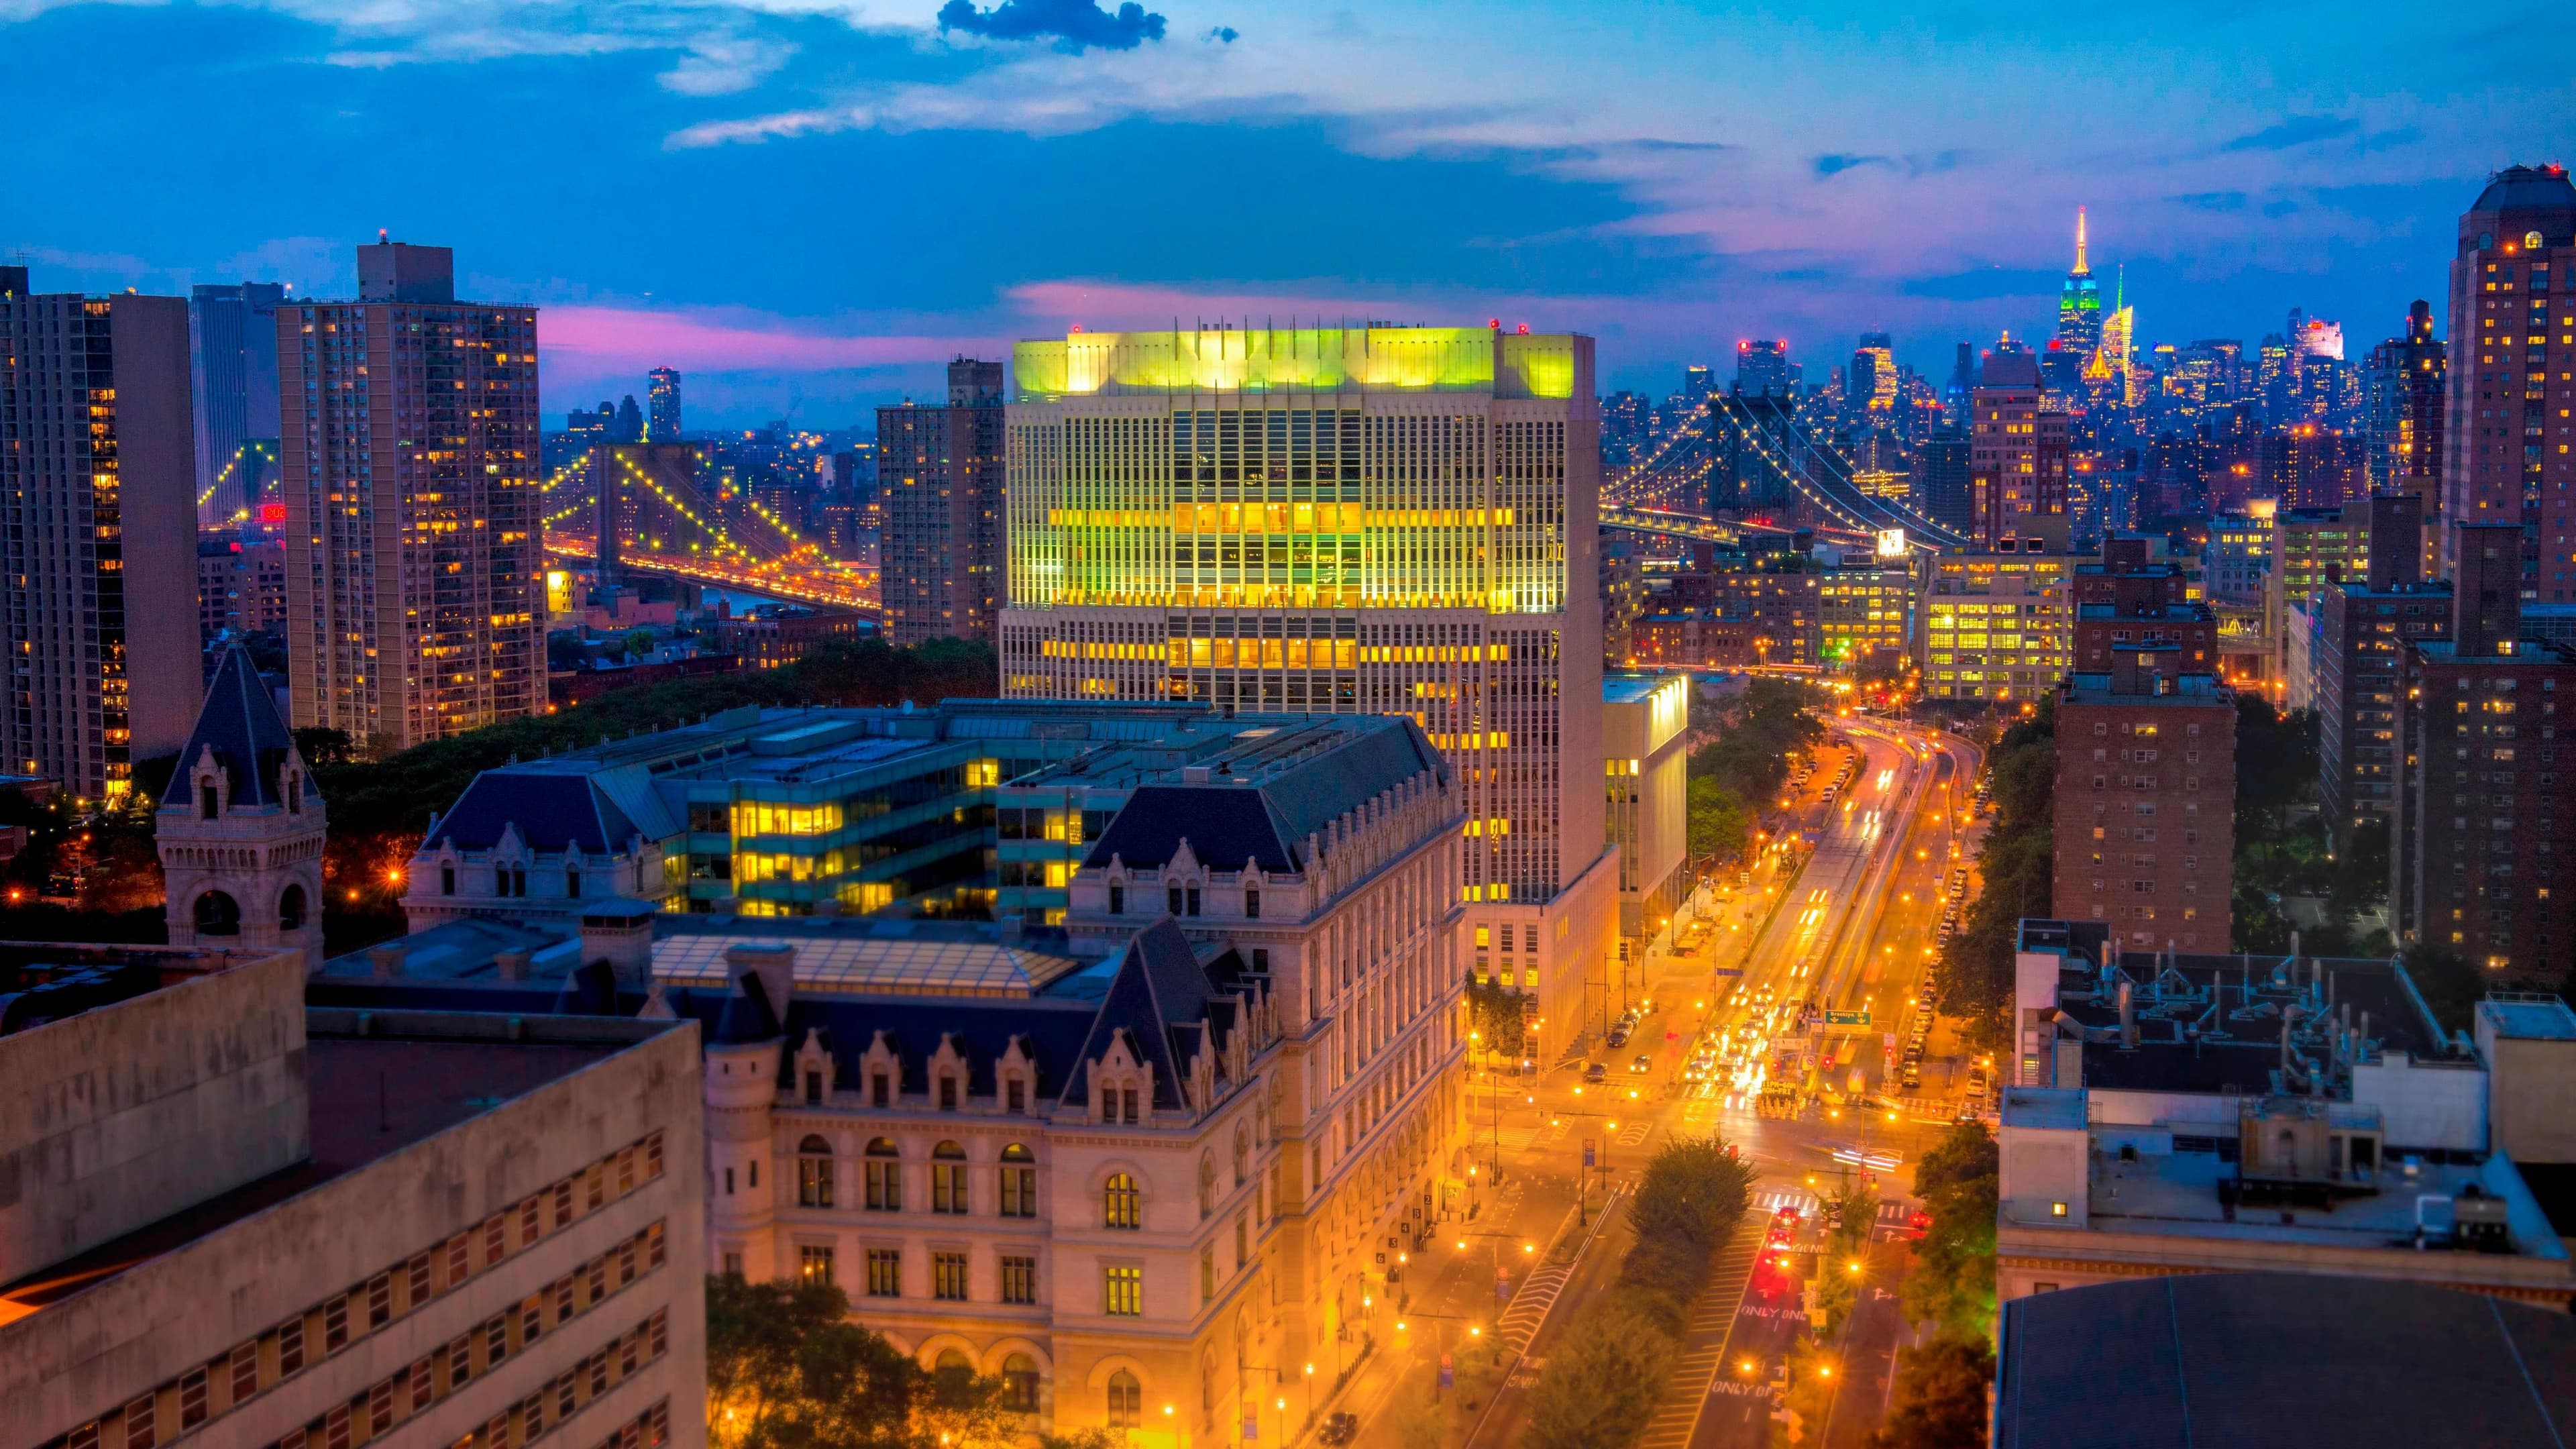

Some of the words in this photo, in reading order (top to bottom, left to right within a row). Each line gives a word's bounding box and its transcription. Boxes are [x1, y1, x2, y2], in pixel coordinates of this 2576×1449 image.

[1741, 1305, 1780, 1318] ONLY
[1782, 1309, 1807, 1321] ONL
[1713, 1381, 1754, 1395] ONLY
